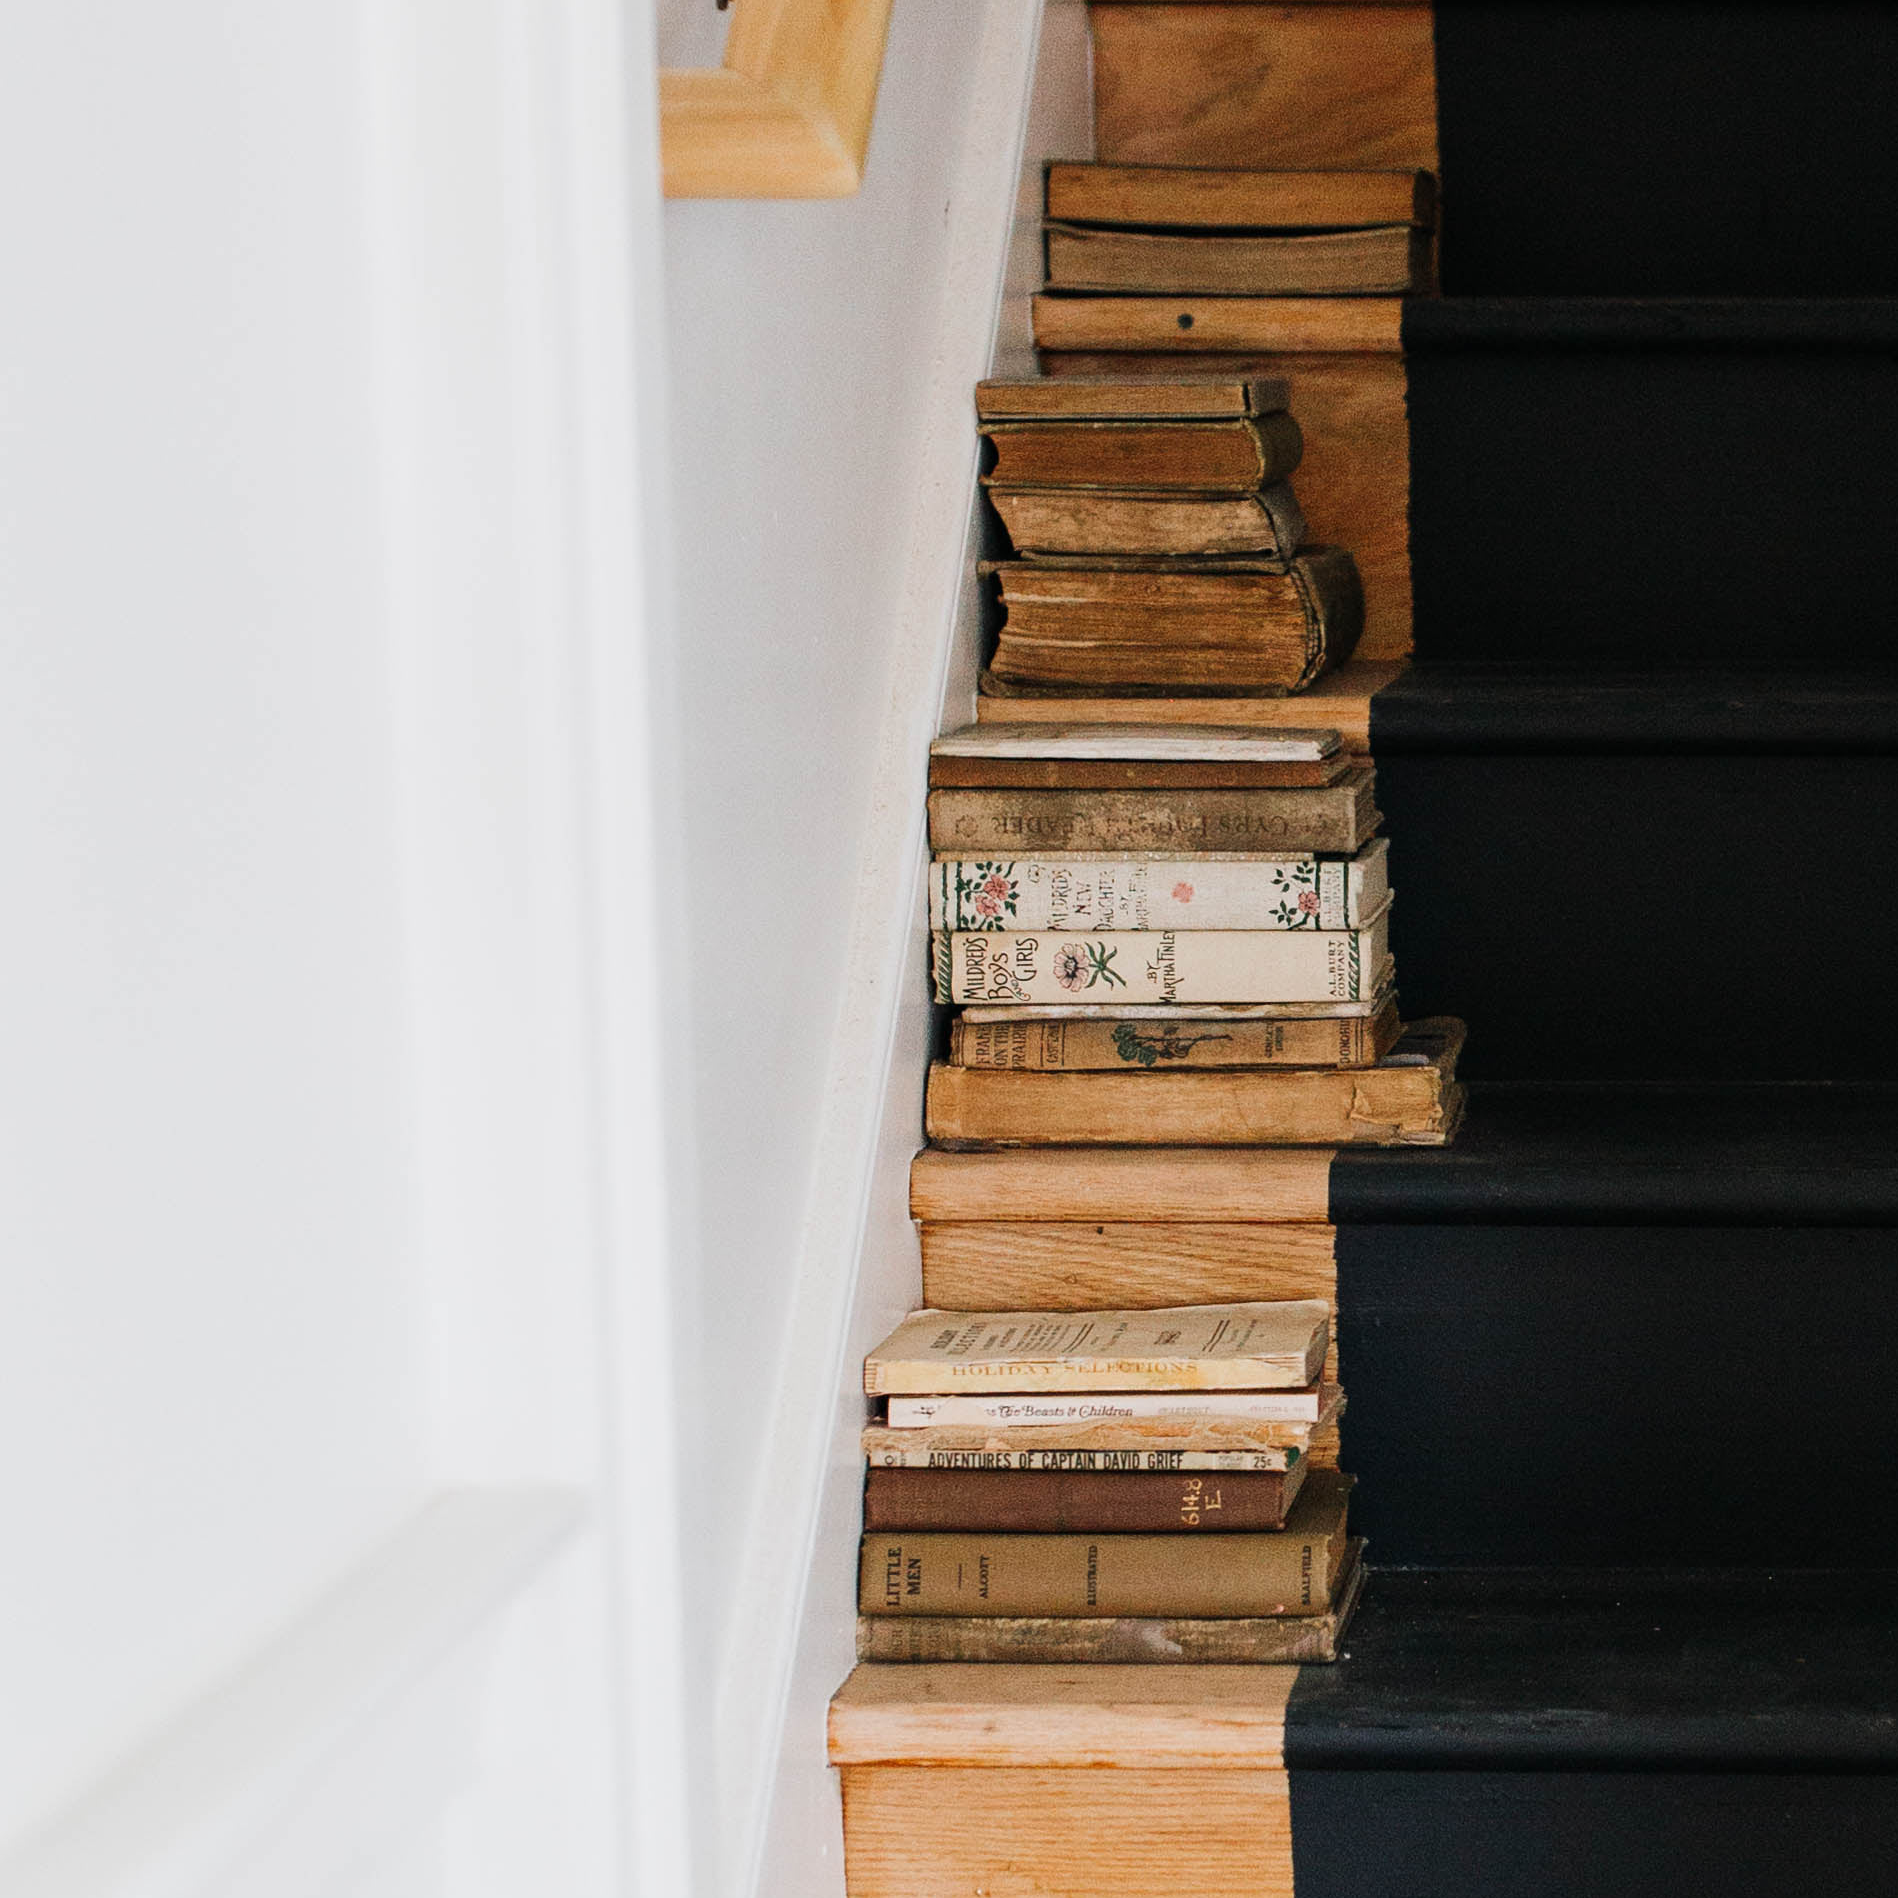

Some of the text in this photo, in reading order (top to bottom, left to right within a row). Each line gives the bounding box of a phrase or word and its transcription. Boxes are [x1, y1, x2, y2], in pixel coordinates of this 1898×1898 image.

[1073, 880, 1092, 916] NEW
[962, 937, 989, 1001] MILDRED'S
[1012, 937, 1039, 982] GIRLS
[1146, 959, 1160, 984] BY
[1157, 930, 1181, 1003] MARTHA FINLEY
[1337, 941, 1346, 997] COMPANY
[952, 1361, 1199, 1377] HOLIDAY SELECTIONS
[1022, 1405, 1065, 1418] Beasts
[1079, 1405, 1134, 1419] Children
[928, 1452, 1184, 1470] ADVENTURES OF CAPTAIN DAVID GRIEF
[1204, 1489, 1222, 1511] E
[886, 1546, 902, 1607] LITTLE
[906, 1558, 921, 1596] MEN
[978, 1554, 990, 1599] ALCOTT
